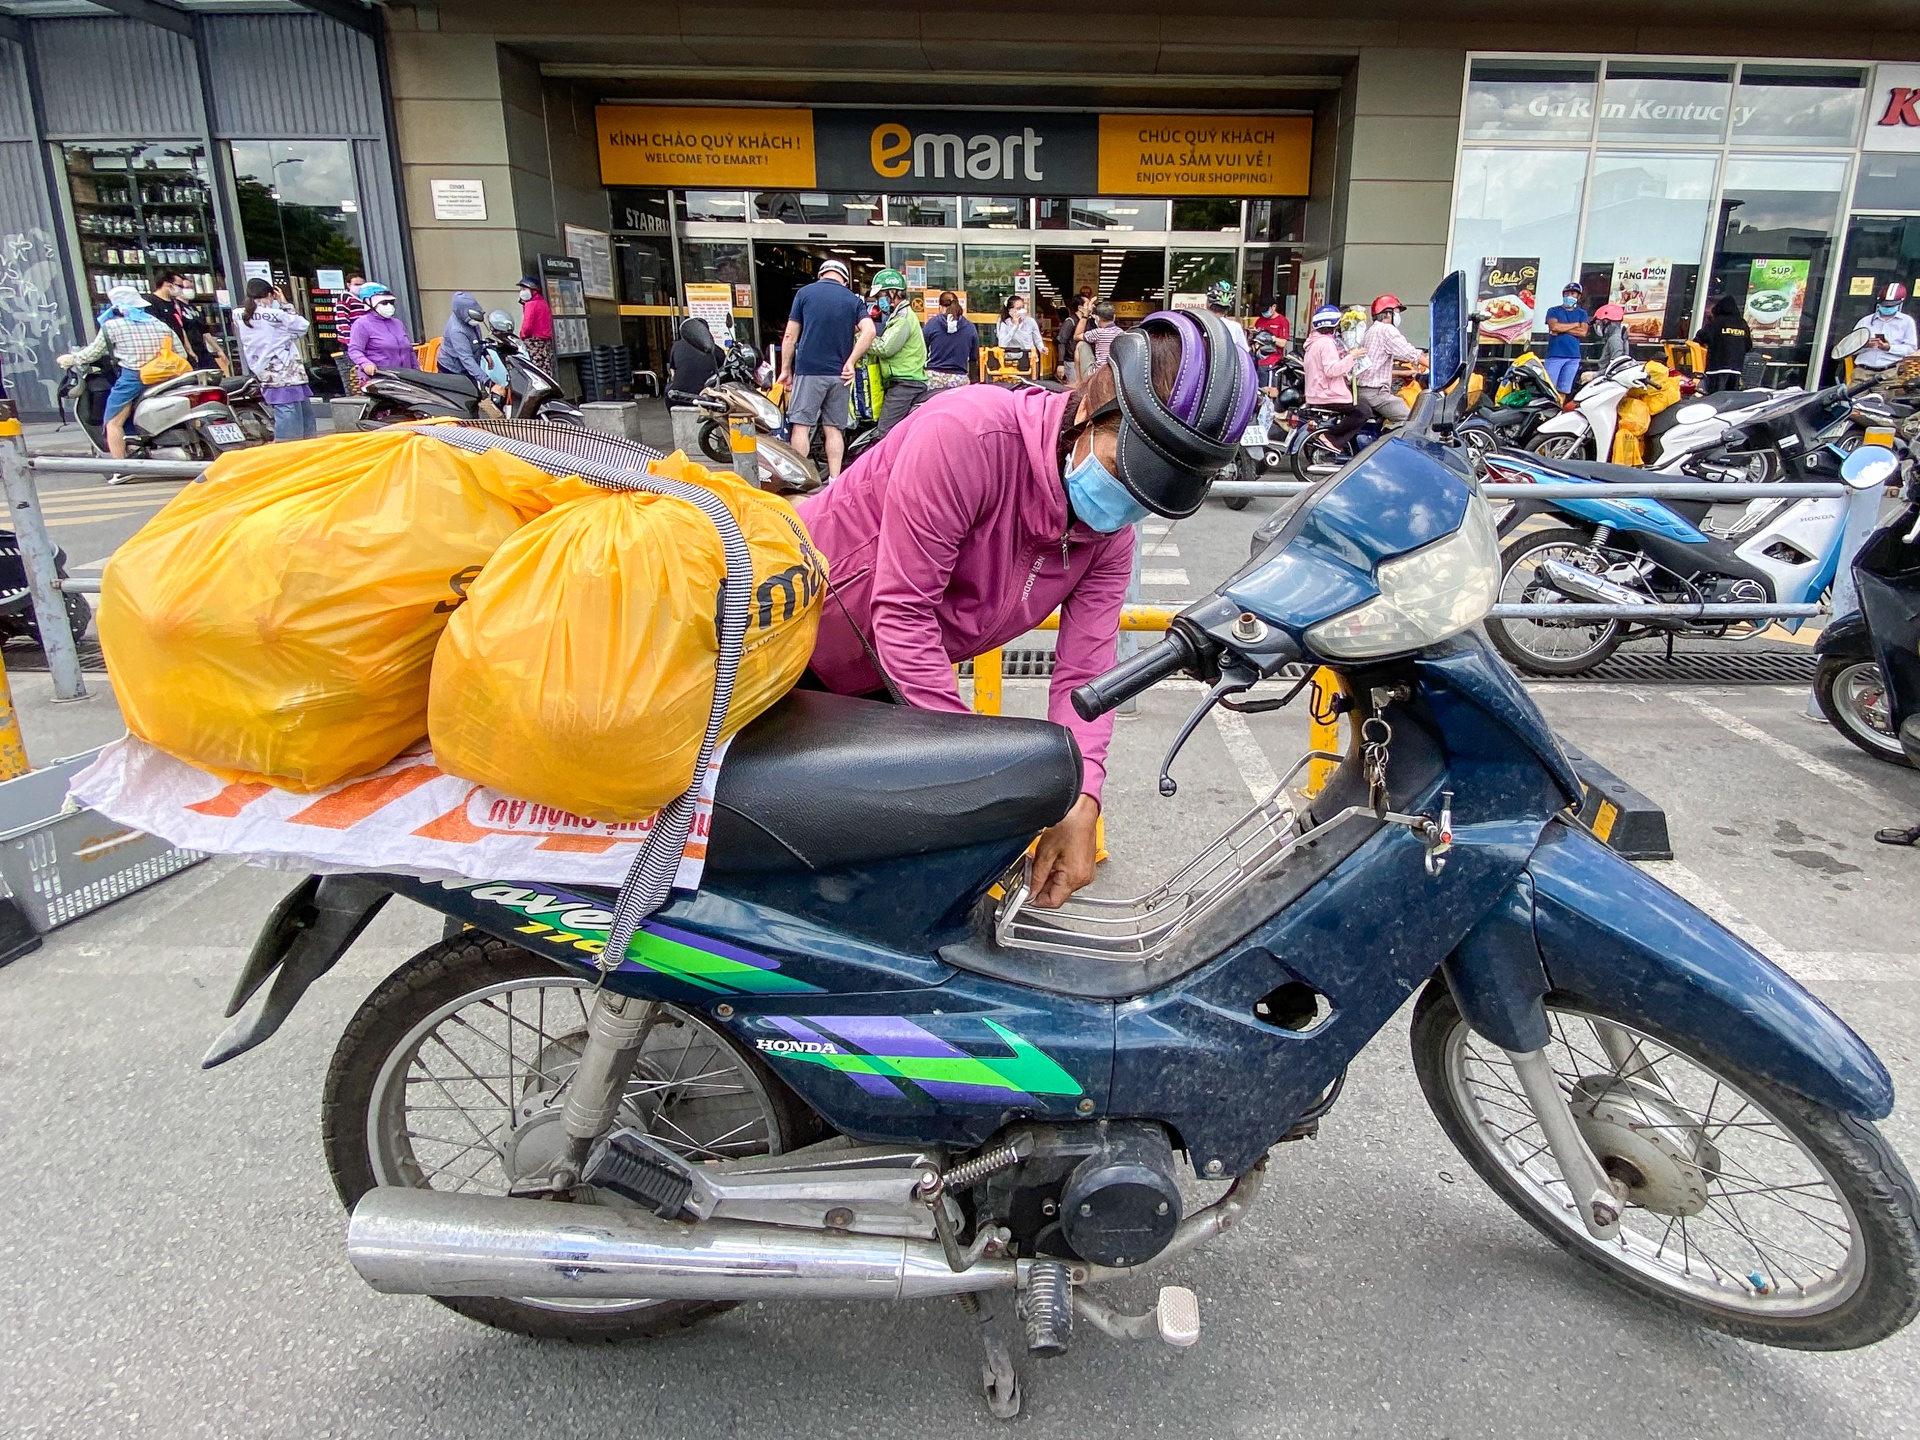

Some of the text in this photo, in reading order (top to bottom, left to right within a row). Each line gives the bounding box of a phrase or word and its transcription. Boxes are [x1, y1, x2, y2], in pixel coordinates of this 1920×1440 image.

[609, 130, 648, 147] KÍNH
[652, 131, 697, 148] CHÀO
[701, 131, 734, 151] QUÝ
[738, 132, 792, 149] KHÁCH
[1138, 127, 1275, 145] CHÚC QUÝ KHÁCH
[645, 153, 702, 164] WELCOME
[704, 154, 721, 165] TO
[723, 154, 762, 165] EMART
[870, 122, 1043, 181] emart
[1140, 153, 1175, 166] MUA
[1215, 153, 1241, 167] VUI
[1136, 172, 1171, 184] ENJOY
[1174, 172, 1206, 183] YOUR
[1208, 172, 1267, 183] SHOPPING
[1800, 514, 1836, 523] HONDA
[1034, 555, 1046, 573] NEW
[1021, 573, 1037, 602] MODEL
[755, 1038, 838, 1054] HONDA
